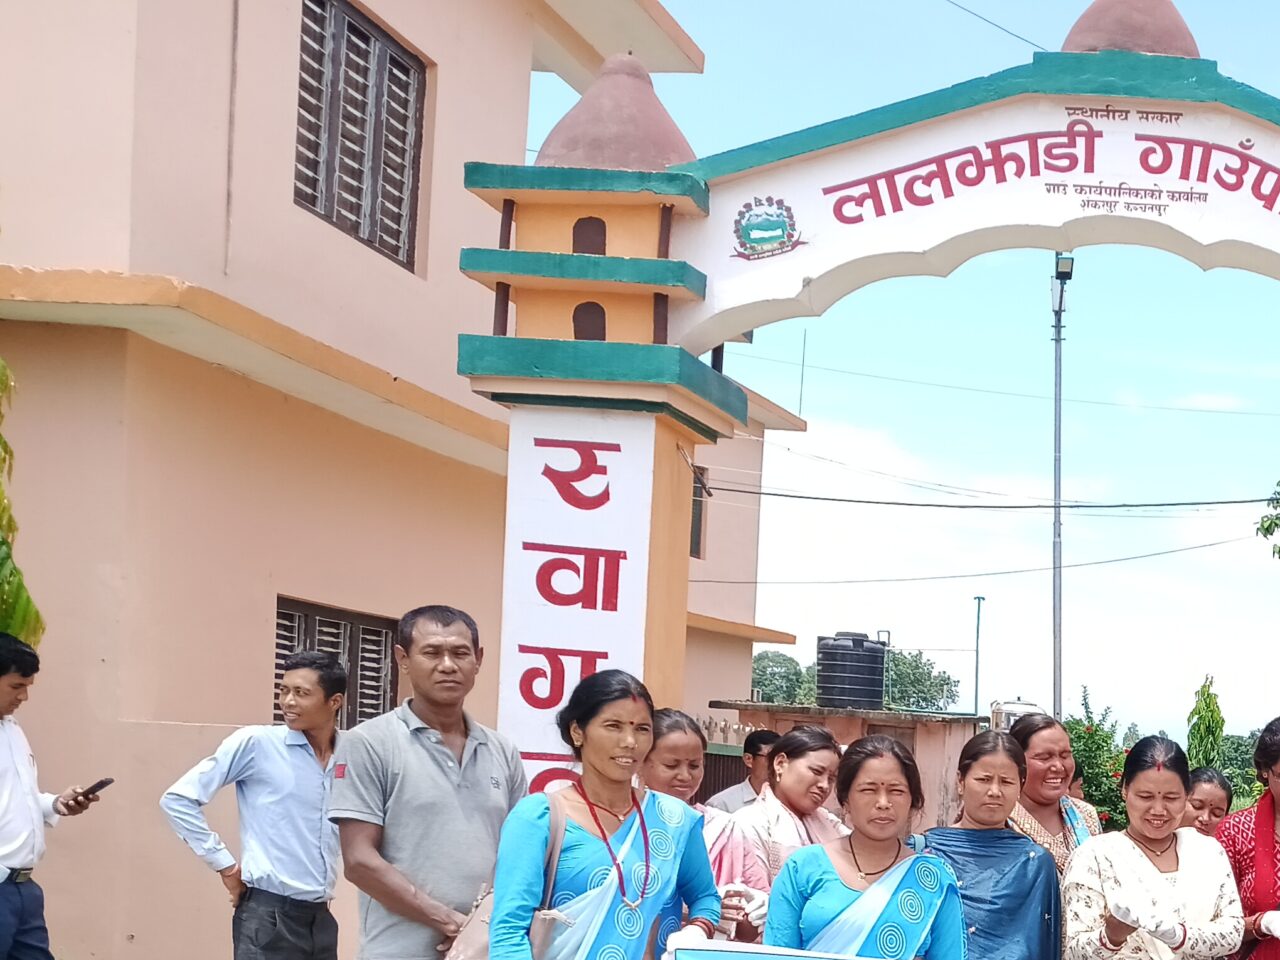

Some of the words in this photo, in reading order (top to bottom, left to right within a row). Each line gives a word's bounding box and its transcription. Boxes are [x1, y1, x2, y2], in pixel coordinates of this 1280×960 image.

[1065, 104, 1130, 121] स्थानीय
[1137, 110, 1183, 125] सरकार
[821, 118, 1103, 224] लालझाडी
